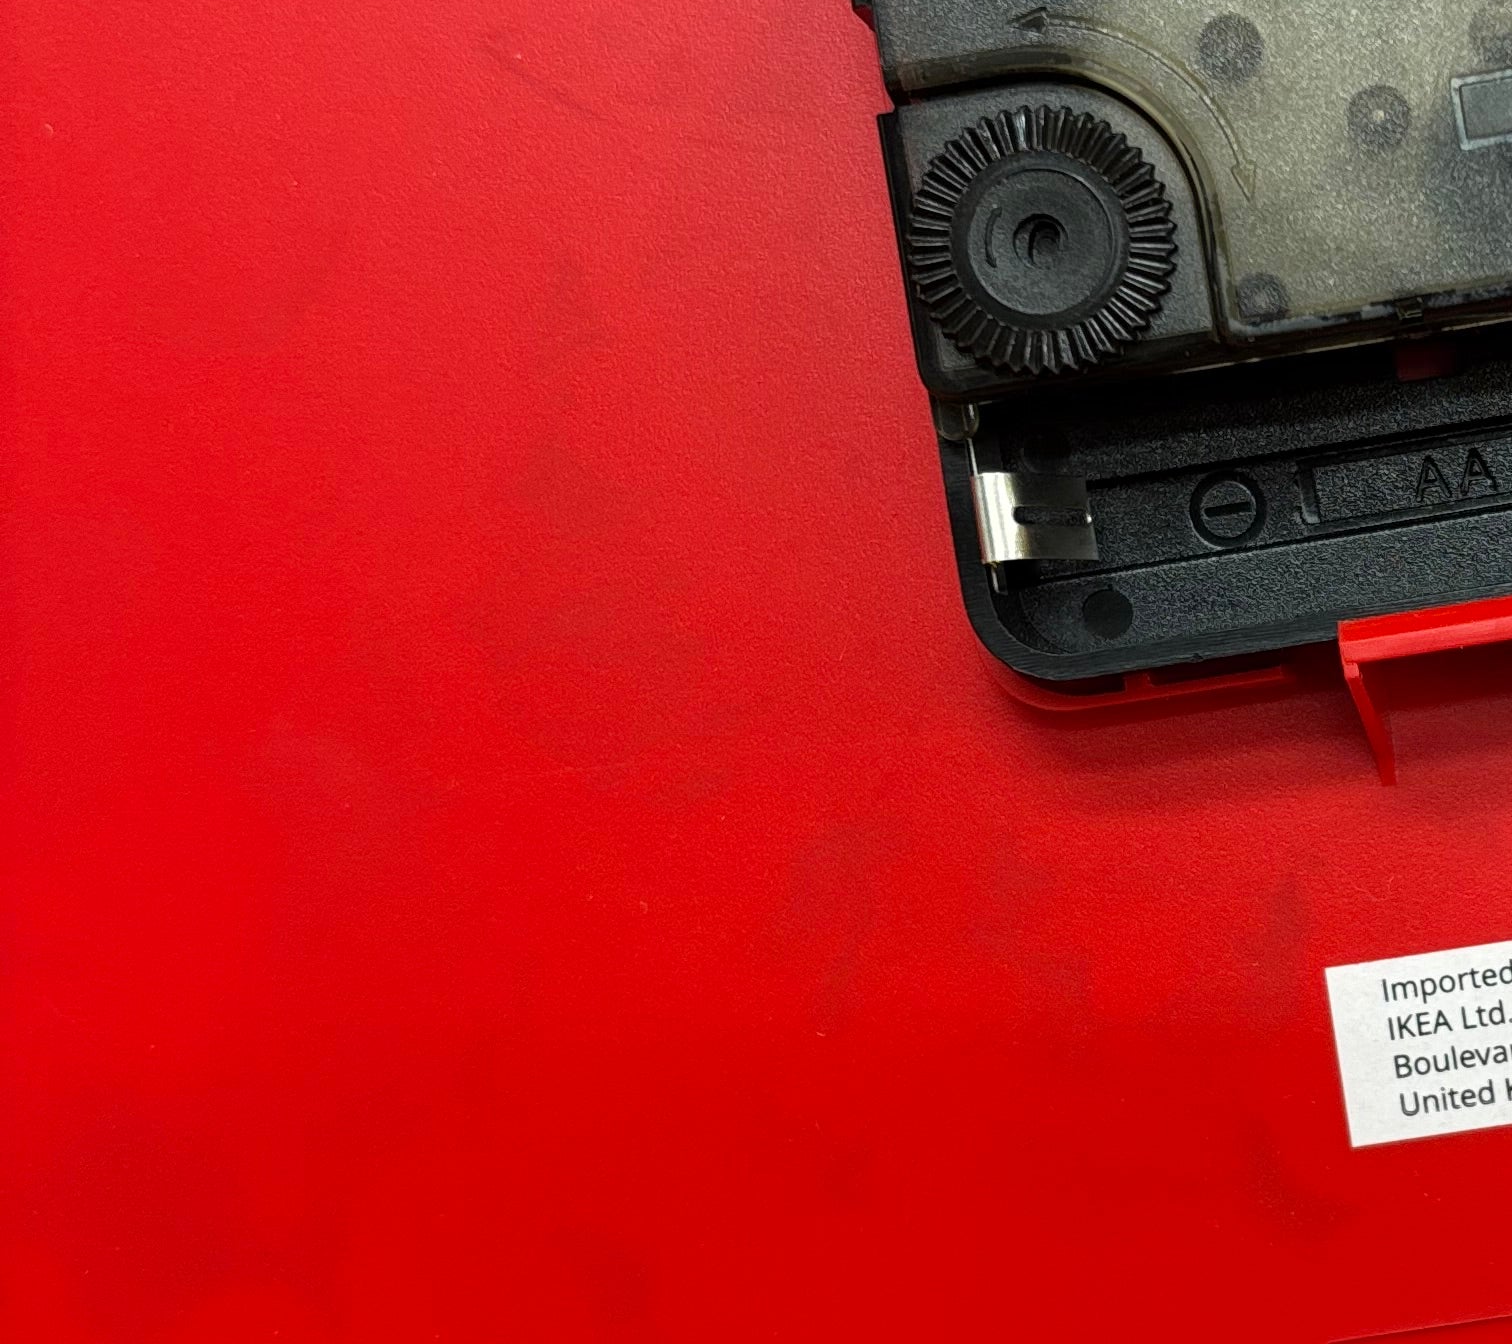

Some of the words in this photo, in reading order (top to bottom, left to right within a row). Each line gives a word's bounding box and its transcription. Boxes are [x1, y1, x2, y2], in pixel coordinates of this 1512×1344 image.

[1416, 448, 1497, 503] AA
[1387, 1009, 1452, 1041] IKEA
[1400, 1080, 1496, 1116] United
